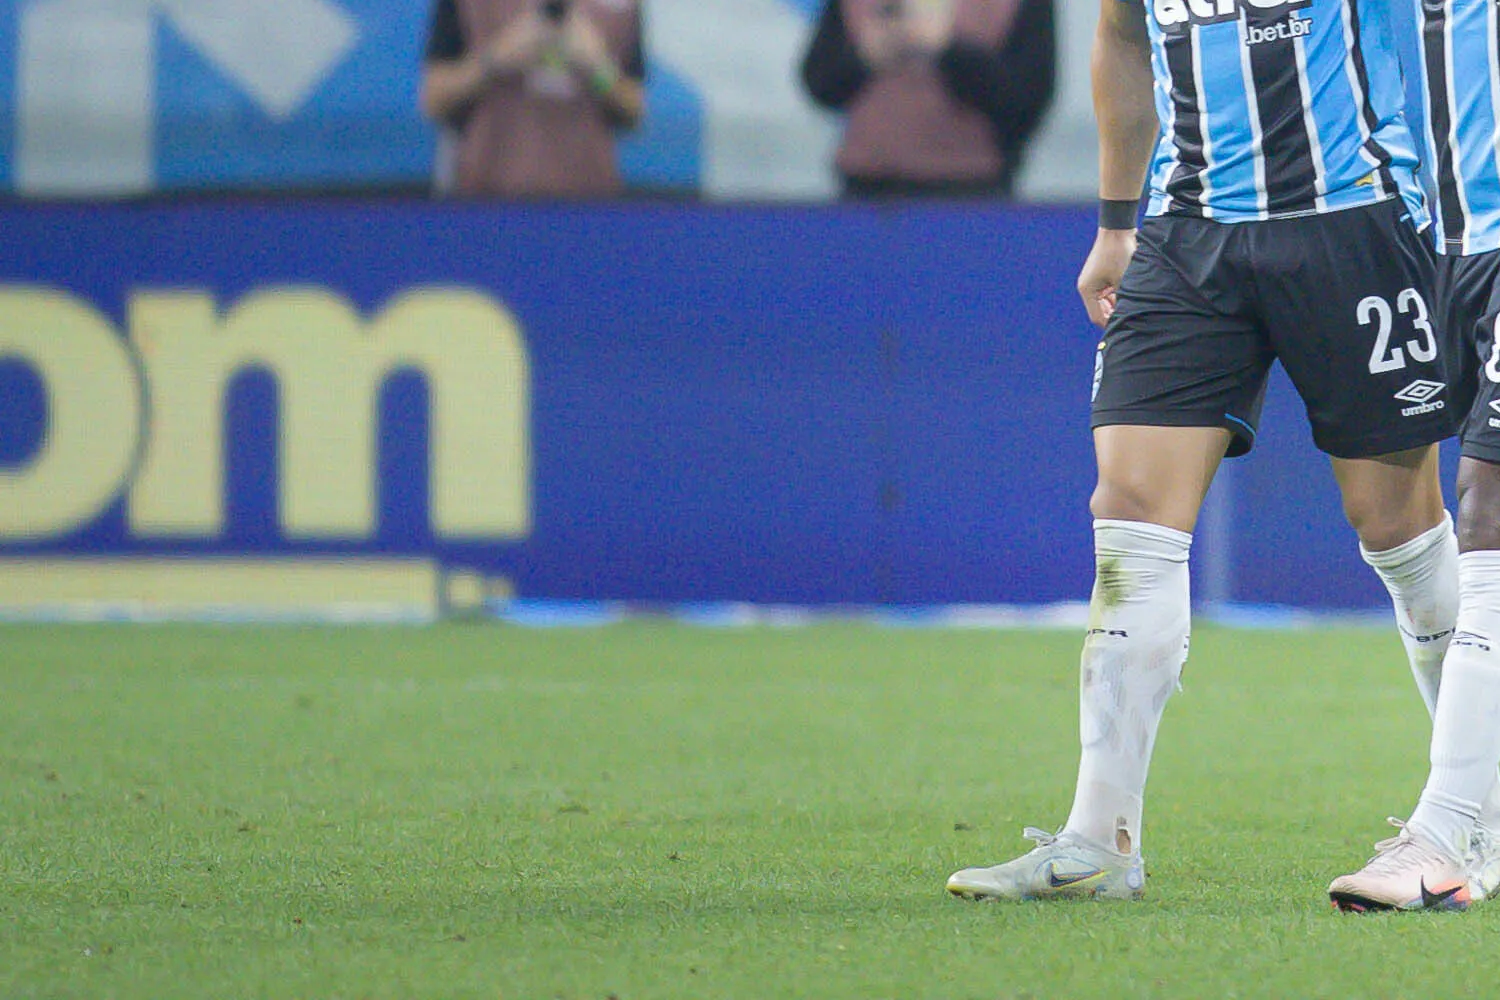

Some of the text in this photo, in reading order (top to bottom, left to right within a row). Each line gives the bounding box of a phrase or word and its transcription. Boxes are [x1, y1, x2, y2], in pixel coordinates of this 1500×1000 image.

[1247, 14, 1313, 45] .bet.br
[1356, 288, 1437, 375] 23
[1401, 399, 1445, 417] umbro
